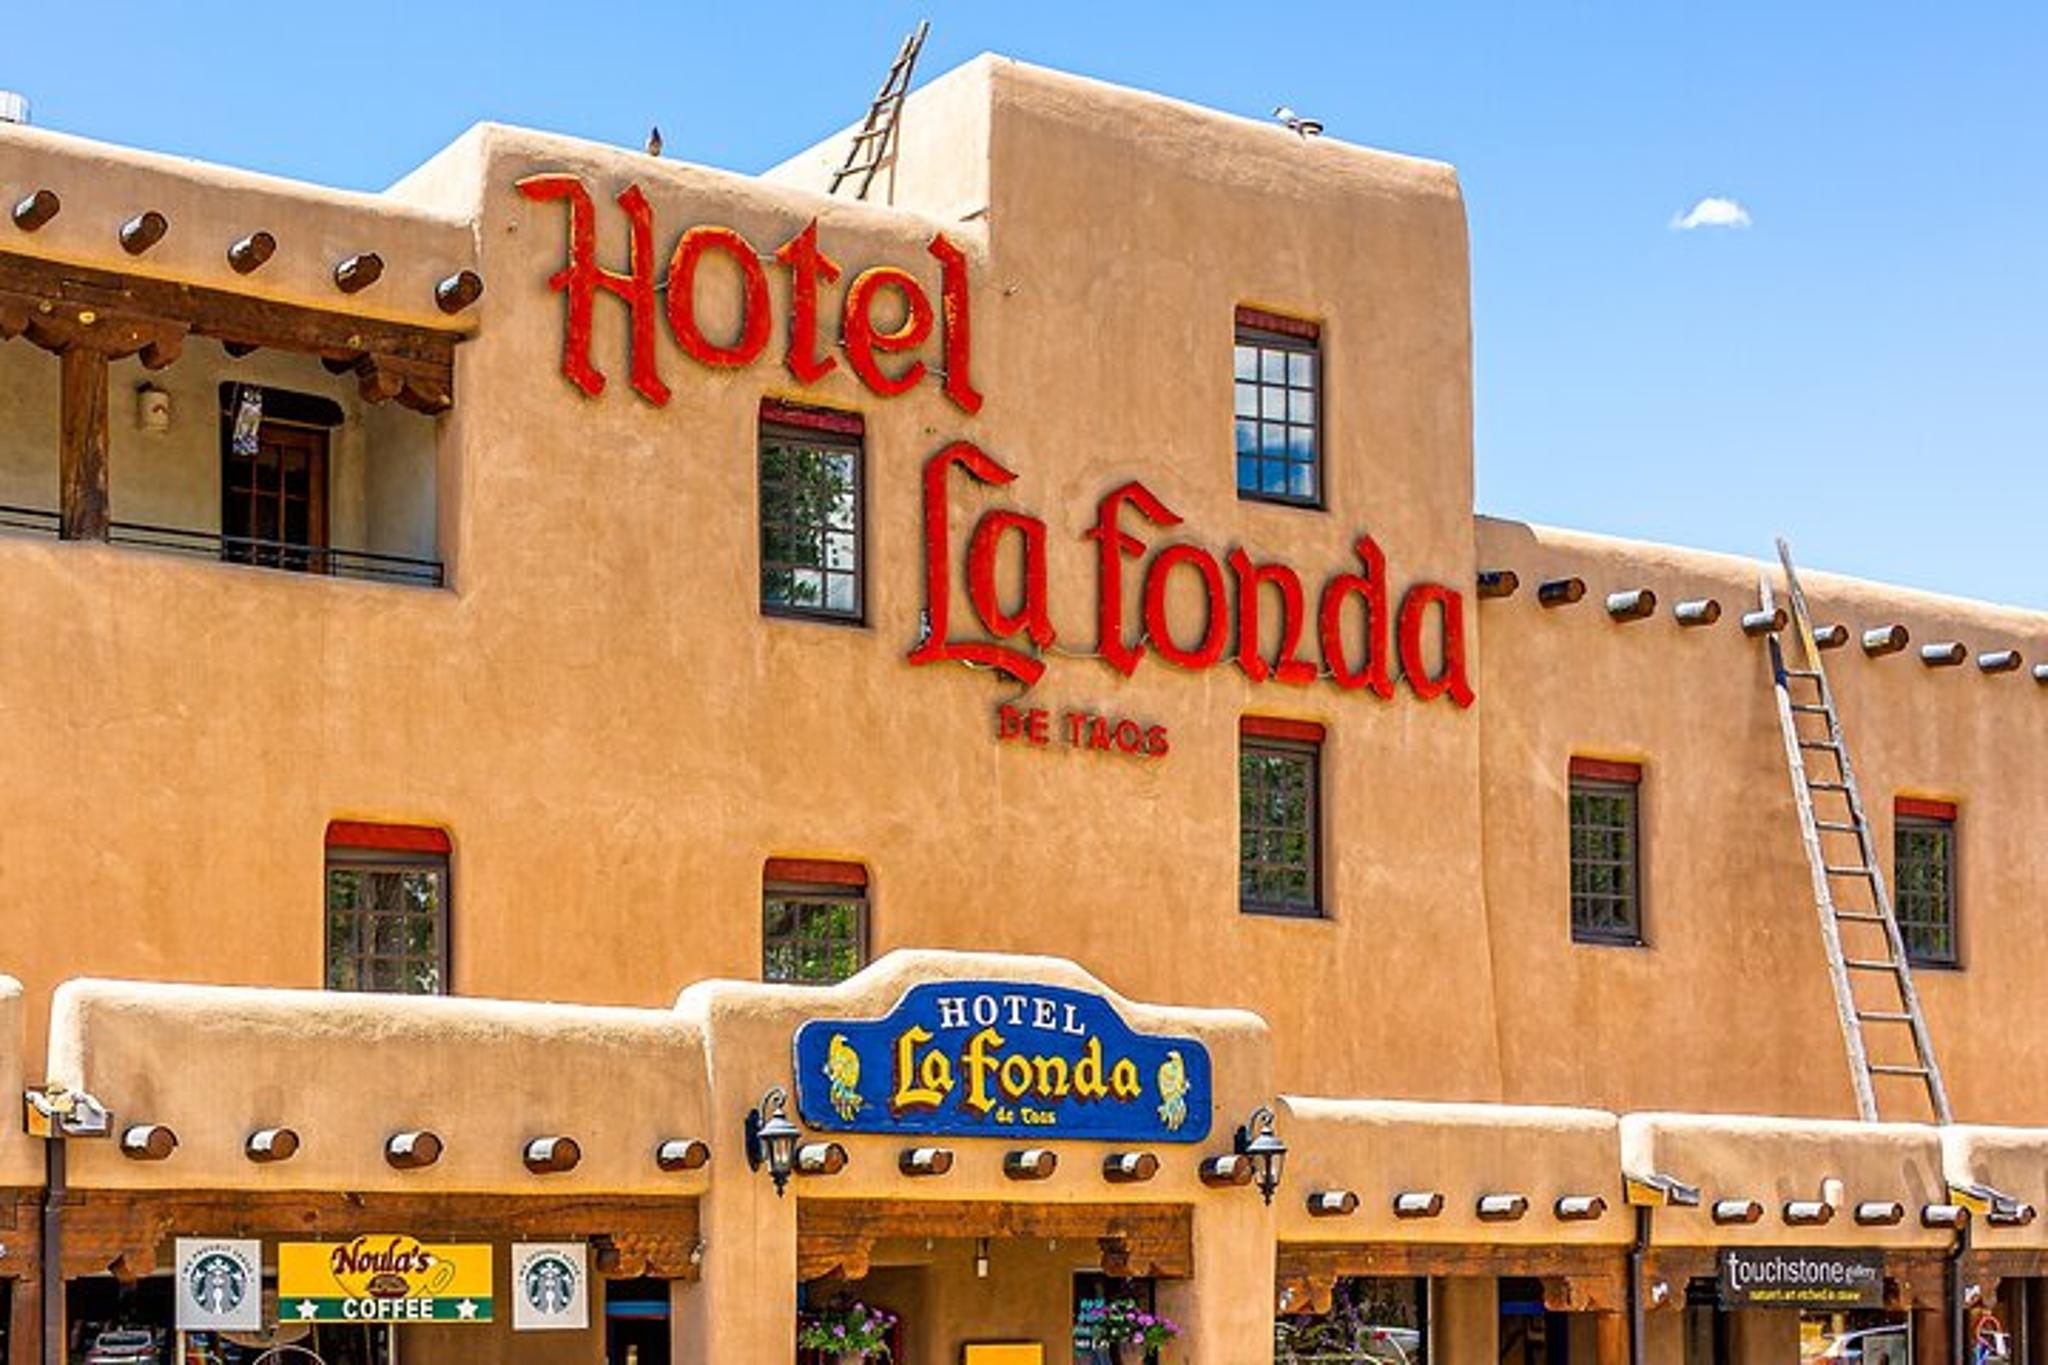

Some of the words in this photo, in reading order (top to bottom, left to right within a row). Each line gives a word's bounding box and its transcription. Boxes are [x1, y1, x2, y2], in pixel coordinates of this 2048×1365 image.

[518, 176, 984, 415] Hotel
[907, 440, 1057, 688] La
[998, 703, 1050, 746] DE
[1066, 712, 1170, 758] TAOS
[938, 994, 1086, 1036] HOTEL
[893, 1024, 955, 1110] La
[331, 1237, 431, 1275] Noula's
[1728, 1252, 1844, 1291] touchstone
[341, 1298, 434, 1320] COFFEE
